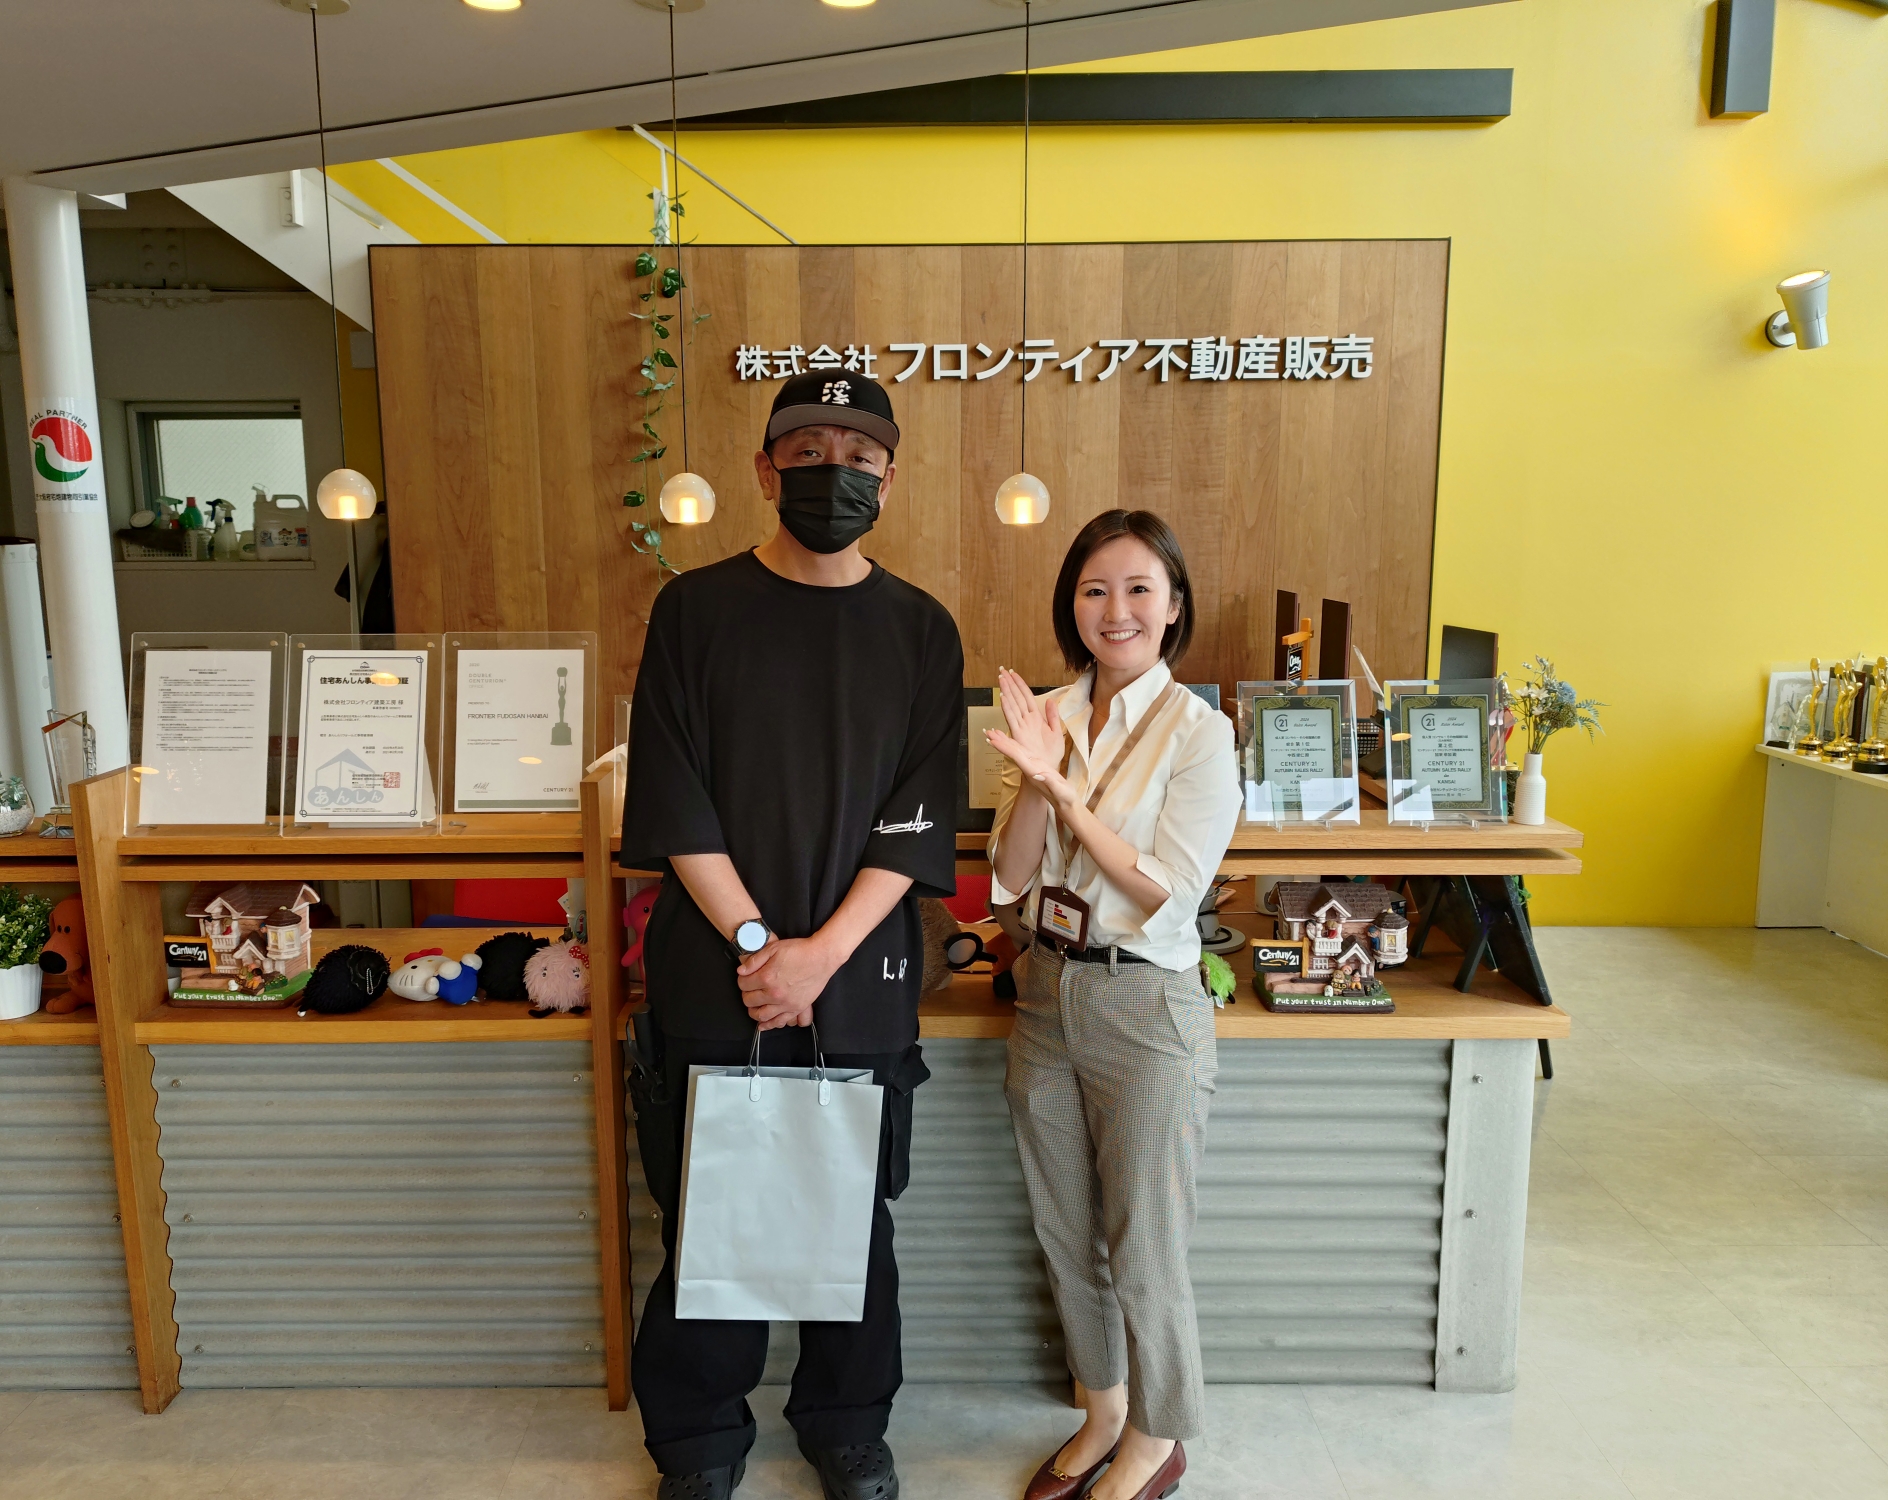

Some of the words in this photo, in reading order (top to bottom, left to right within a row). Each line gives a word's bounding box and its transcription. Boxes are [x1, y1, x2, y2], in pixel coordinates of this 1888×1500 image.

[46, 409, 88, 430] PARTNER
[169, 944, 199, 957] Century
[198, 950, 207, 962] 21
[1258, 948, 1291, 961] Century
[1289, 951, 1299, 966] 21
[173, 992, 187, 1000] Put
[188, 993, 203, 1001] your
[206, 992, 225, 1001] trust
[226, 993, 235, 1001] in
[1291, 998, 1308, 1006] your
[1333, 998, 1342, 1006] in
[1343, 998, 1370, 1006] Number
